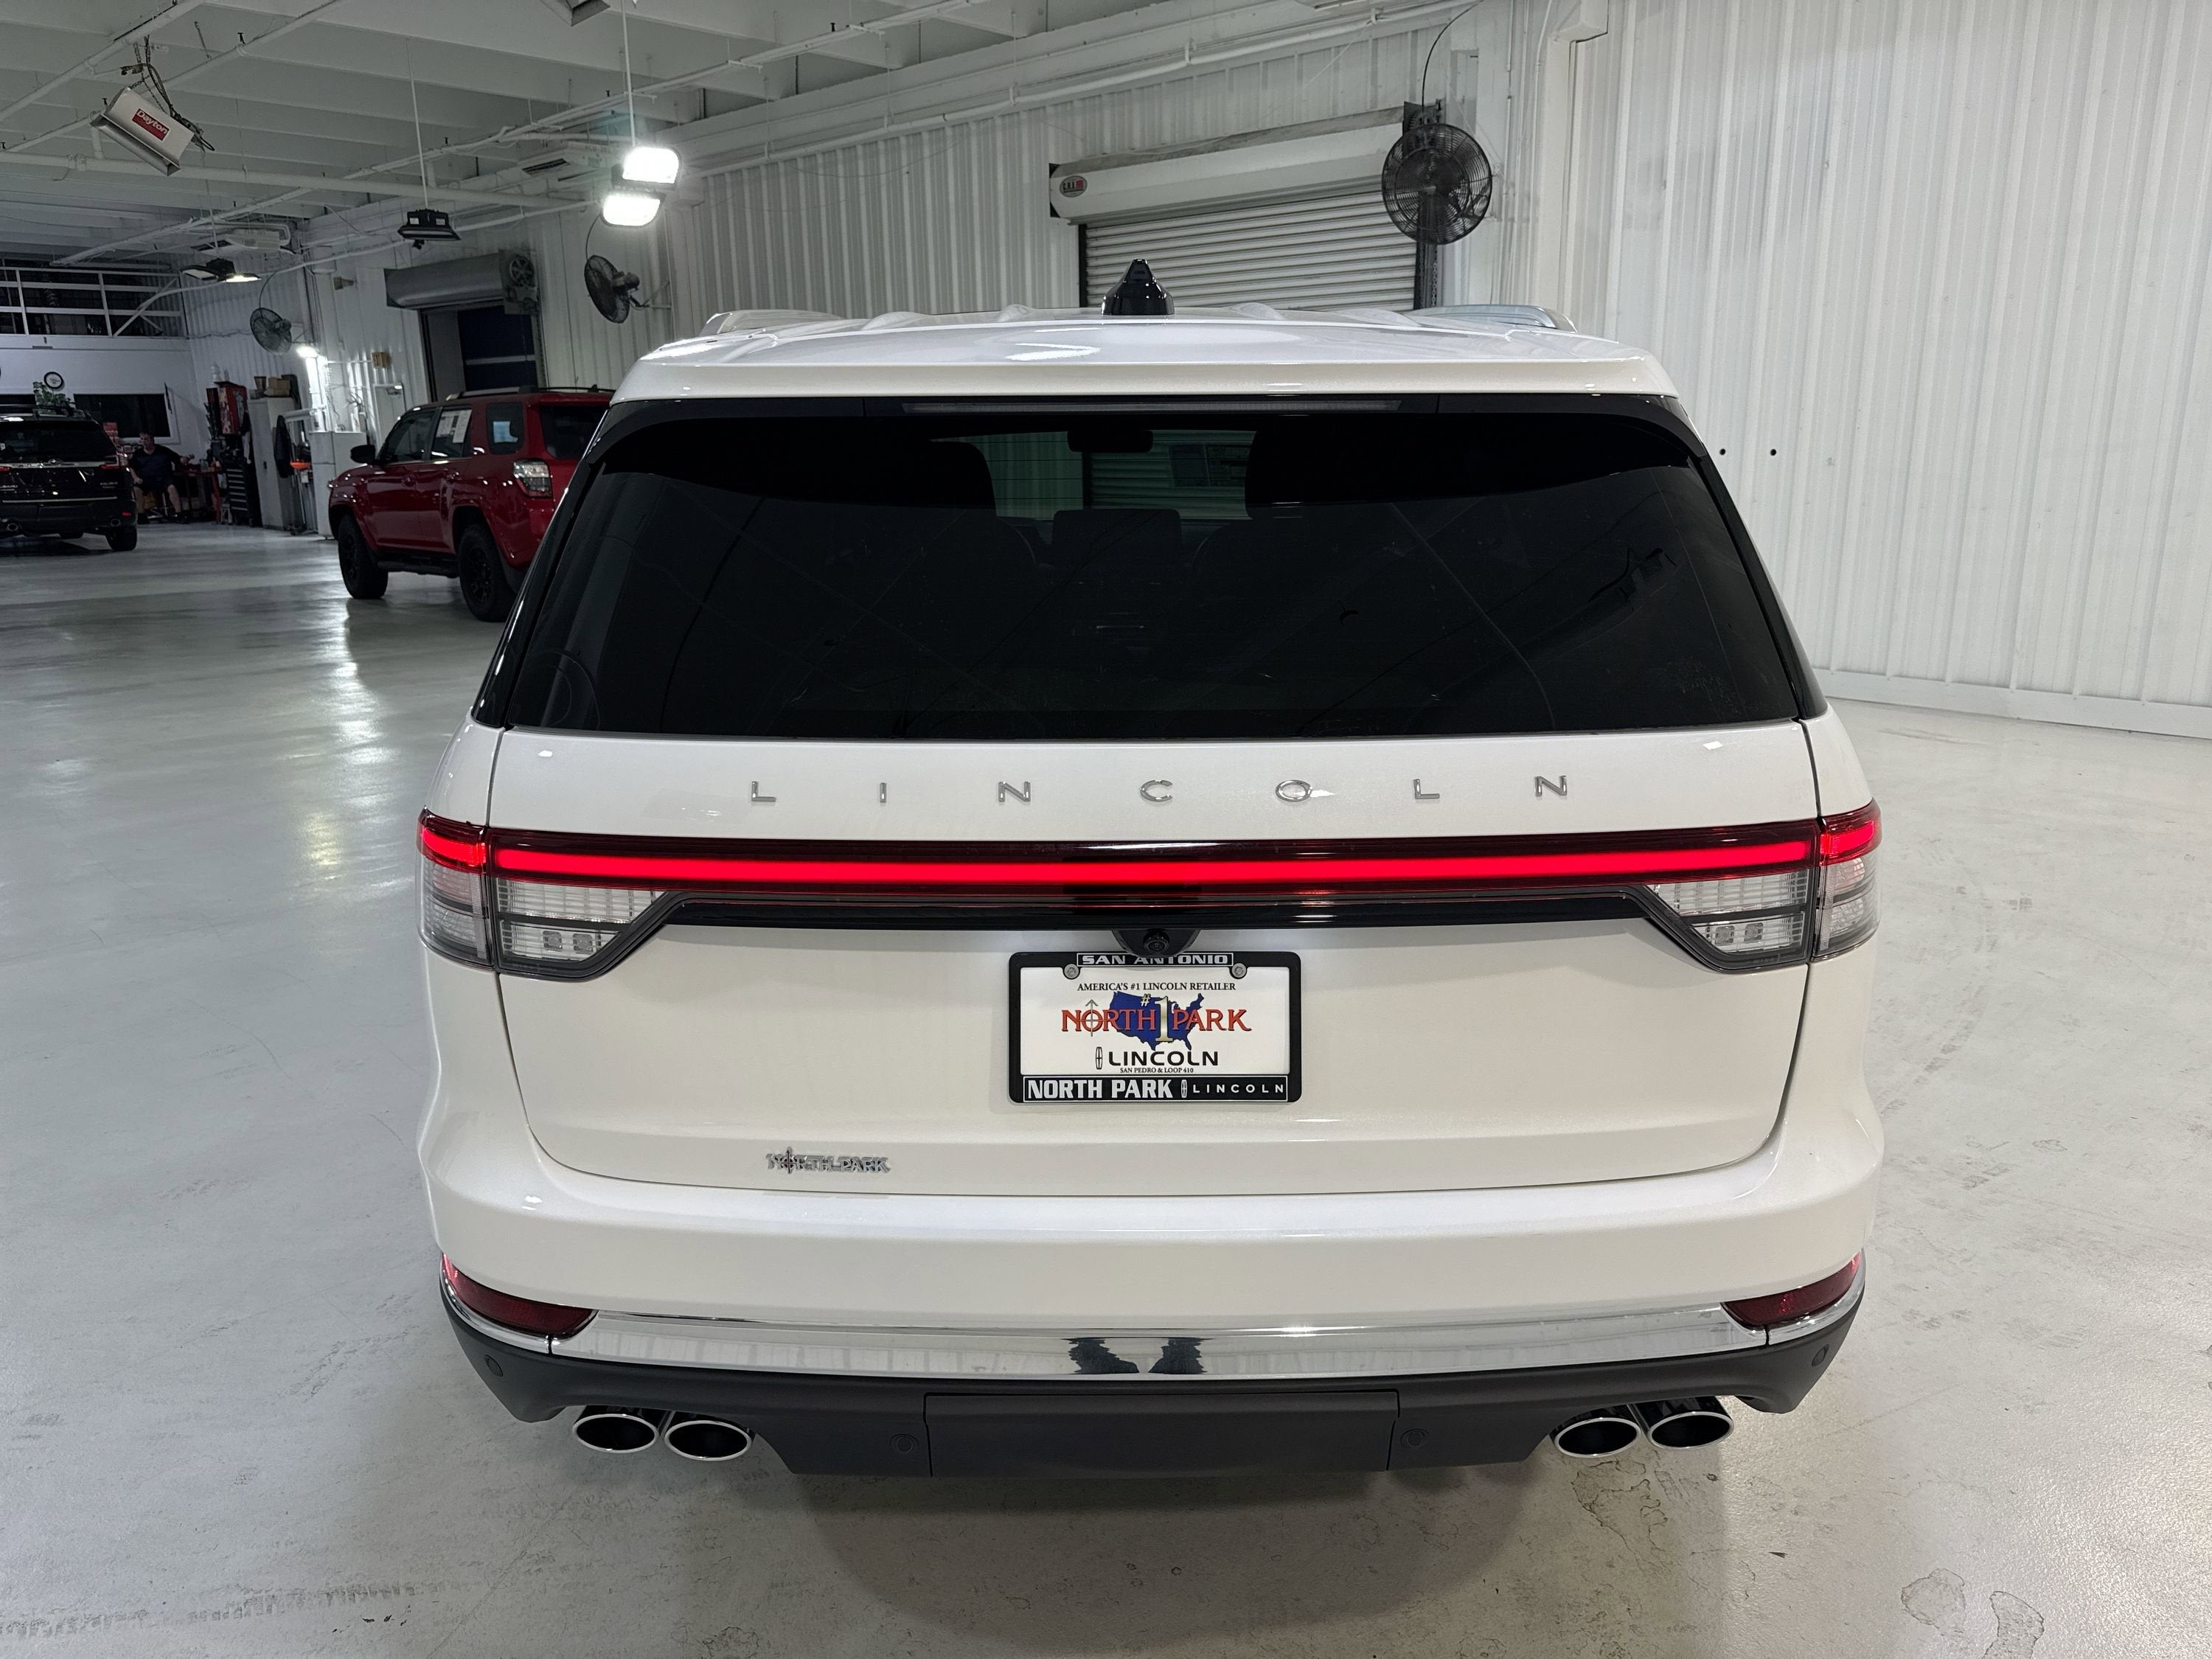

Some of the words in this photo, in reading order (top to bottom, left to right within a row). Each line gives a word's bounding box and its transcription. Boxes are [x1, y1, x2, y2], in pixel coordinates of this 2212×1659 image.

[136, 110, 167, 134] Dayton
[751, 775, 1567, 803] LINCOLN
[1082, 956, 1125, 964] SAN
[1062, 1009, 1156, 1032] NORTH
[1172, 1009, 1252, 1032] PARK
[1109, 1051, 1218, 1065] LINCOLN
[1028, 1079, 1102, 1099] NORTH
[1111, 1079, 1173, 1099] PARK
[1193, 1084, 1284, 1093] LINCOLN
